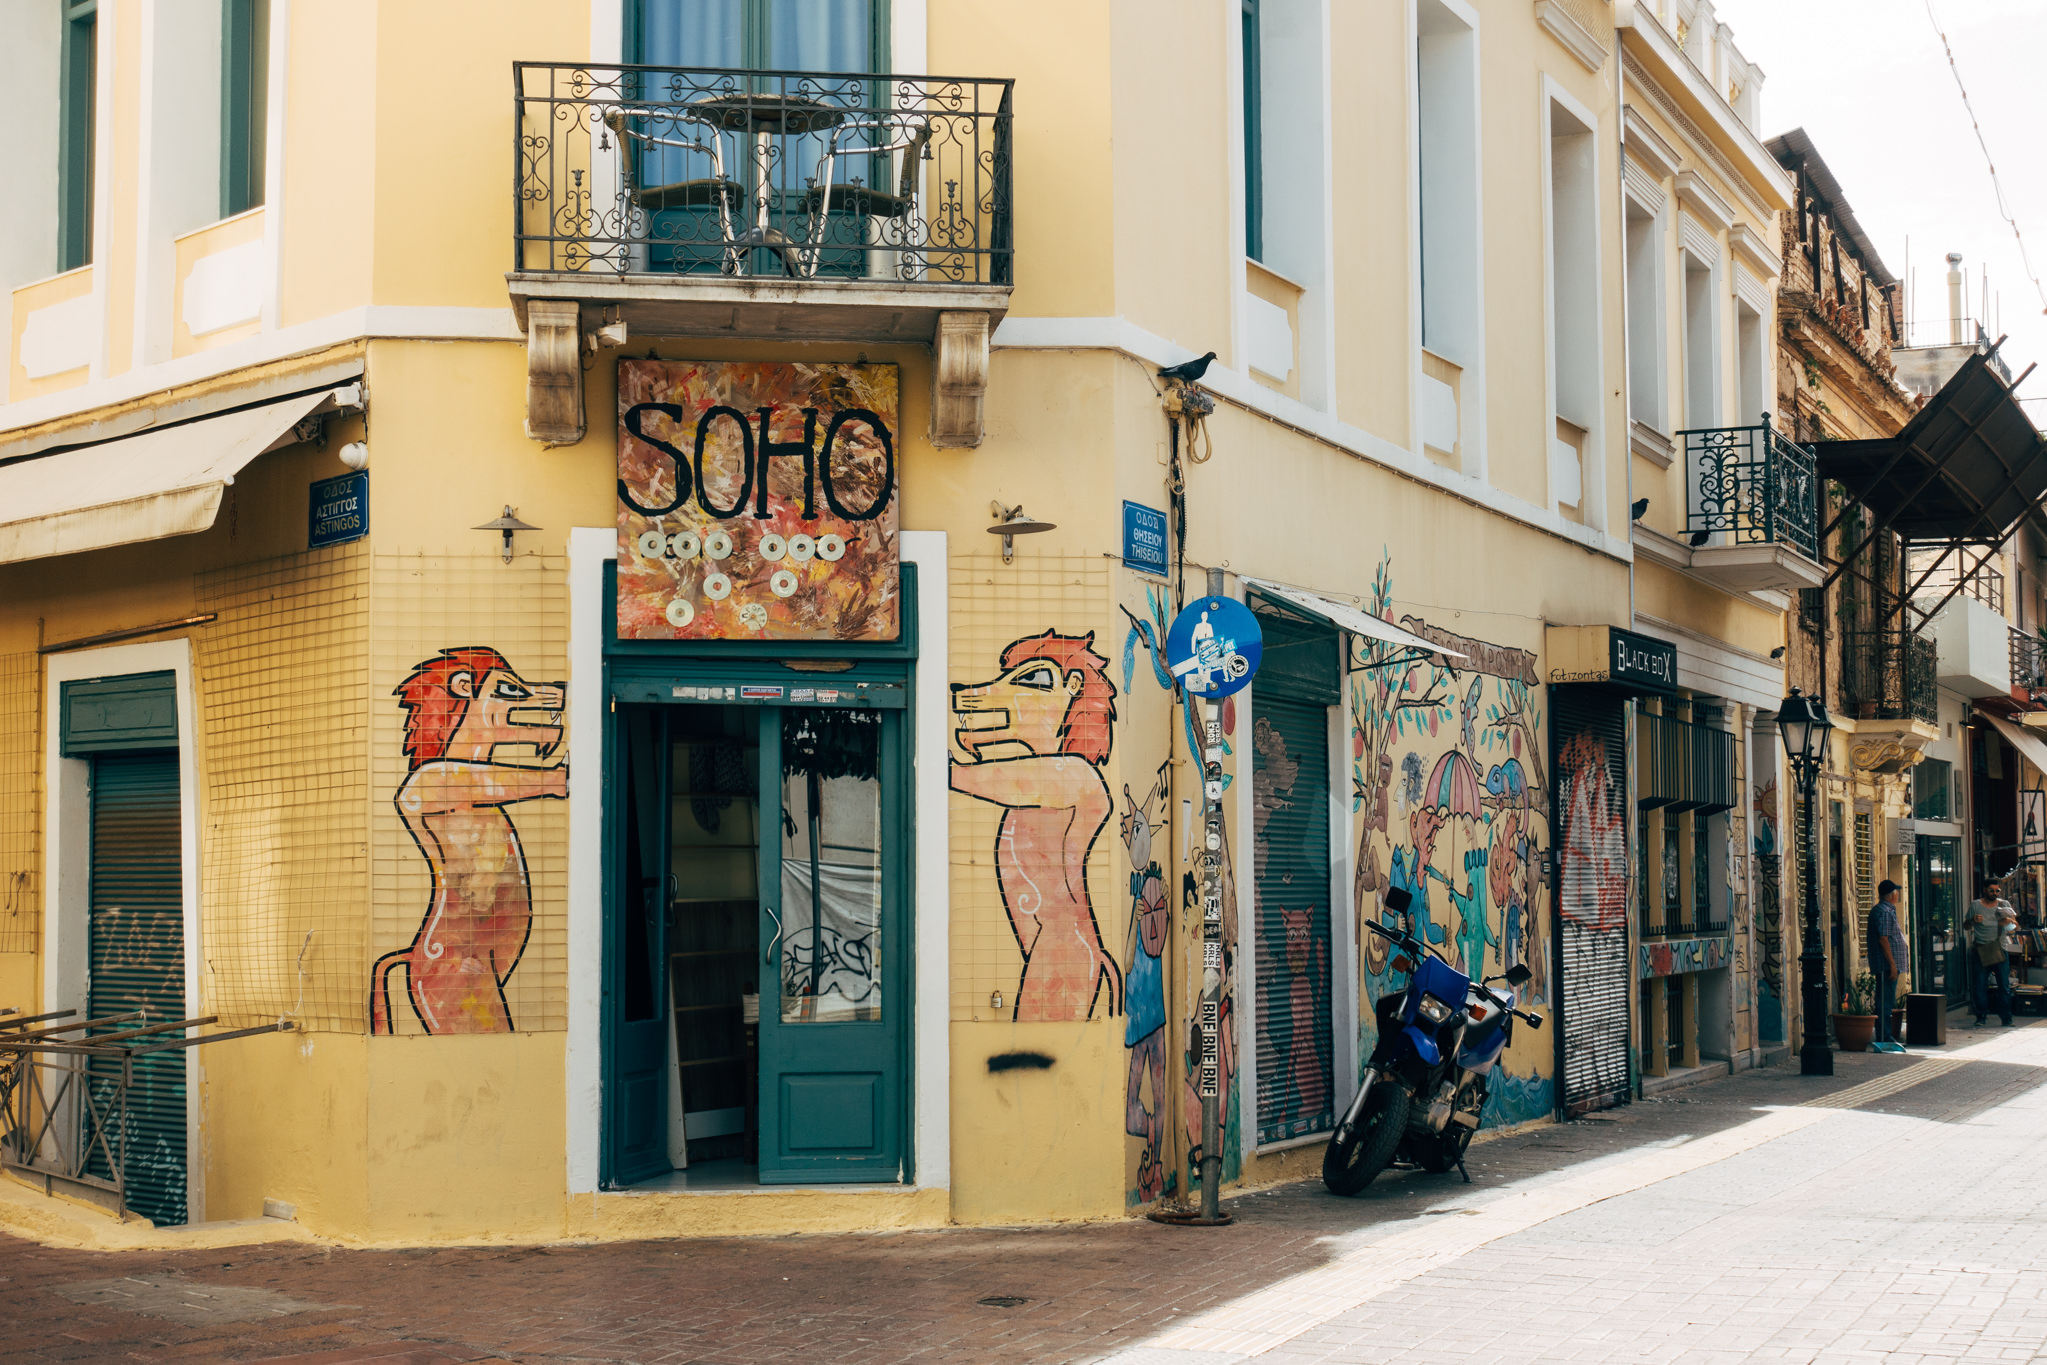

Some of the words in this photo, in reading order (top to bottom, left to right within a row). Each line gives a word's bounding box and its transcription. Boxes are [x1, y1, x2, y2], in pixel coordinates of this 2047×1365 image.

[617, 402, 895, 521] SOHO
[323, 480, 353, 498] ΟΔΟΣ
[316, 496, 358, 520] ΑΣΤΙΓΓΟΣ
[314, 514, 360, 536] ASTINGOS
[1133, 527, 1163, 547] ΘΗΣΕΙΟΥ
[1131, 543, 1163, 564] THISEIOU
[1617, 639, 1650, 672] BLACK
[1651, 651, 1671, 683] BOX
[1203, 1003, 1216, 1030] BNE
[1203, 1035, 1216, 1063] BNE
[1202, 1067, 1216, 1095] BNE
